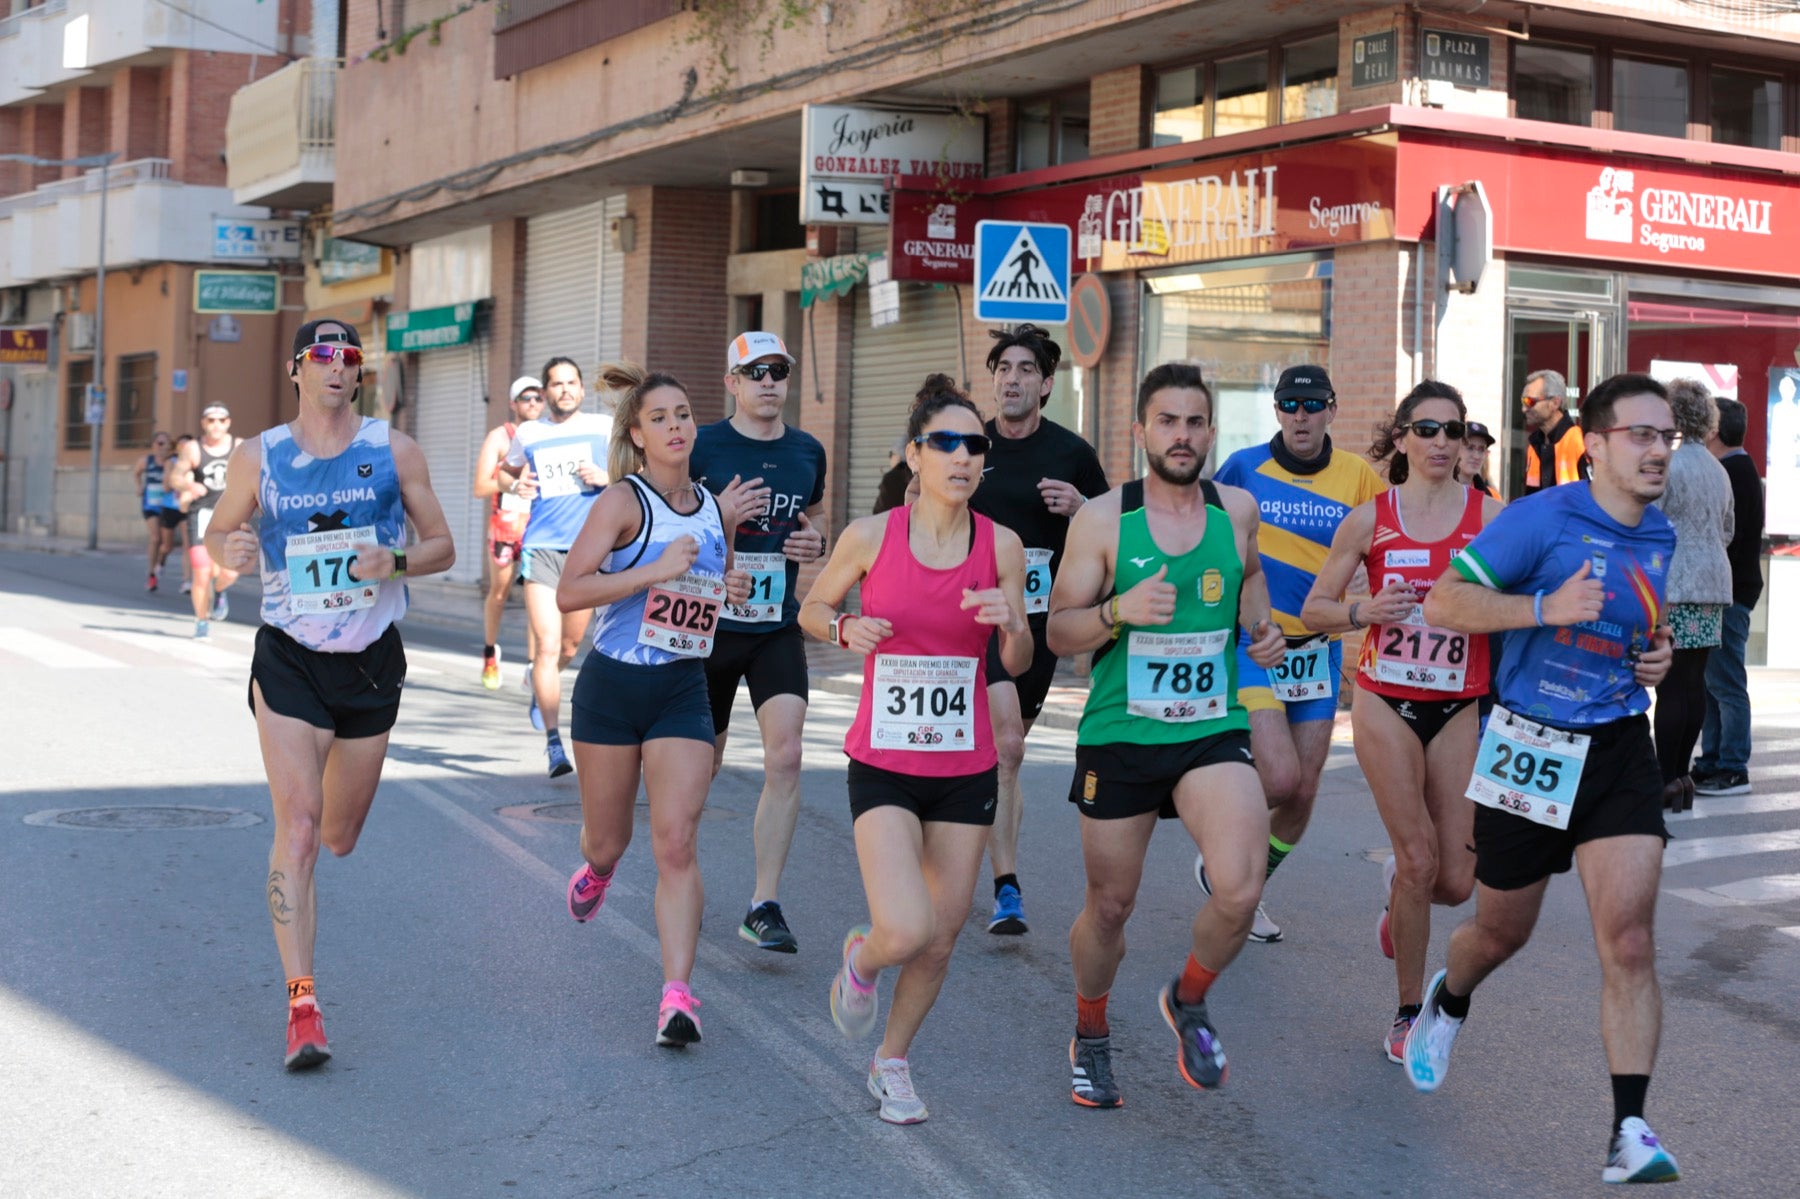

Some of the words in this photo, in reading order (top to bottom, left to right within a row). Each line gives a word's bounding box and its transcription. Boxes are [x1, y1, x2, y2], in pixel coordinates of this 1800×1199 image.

[1367, 39, 1387, 55] CALLE
[1445, 39, 1476, 55] PLAZA
[1365, 62, 1388, 79] REAL
[1430, 61, 1481, 81] ANIMAS
[815, 155, 900, 174] GONZALEZ
[1104, 165, 1278, 253] GENERALI
[1308, 196, 1380, 236] Seguros
[1640, 187, 1772, 235] GENERALI
[1640, 224, 1705, 253] Seguros
[922, 257, 959, 269] Seguros
[281, 493, 328, 510] TODO
[332, 487, 377, 505] SUMA
[1260, 500, 1344, 520] agustinos
[1274, 517, 1333, 528] GRANADA
[1025, 570, 1041, 593] 6
[649, 594, 716, 632] 2025
[1383, 627, 1465, 665] 2178
[900, 659, 917, 668] GRAN
[919, 660, 942, 669] PREMIO
[943, 661, 951, 669] DE
[1275, 653, 1318, 680] 507
[1147, 662, 1214, 694] 788
[886, 685, 967, 717] 3104
[1490, 743, 1563, 793] 295
